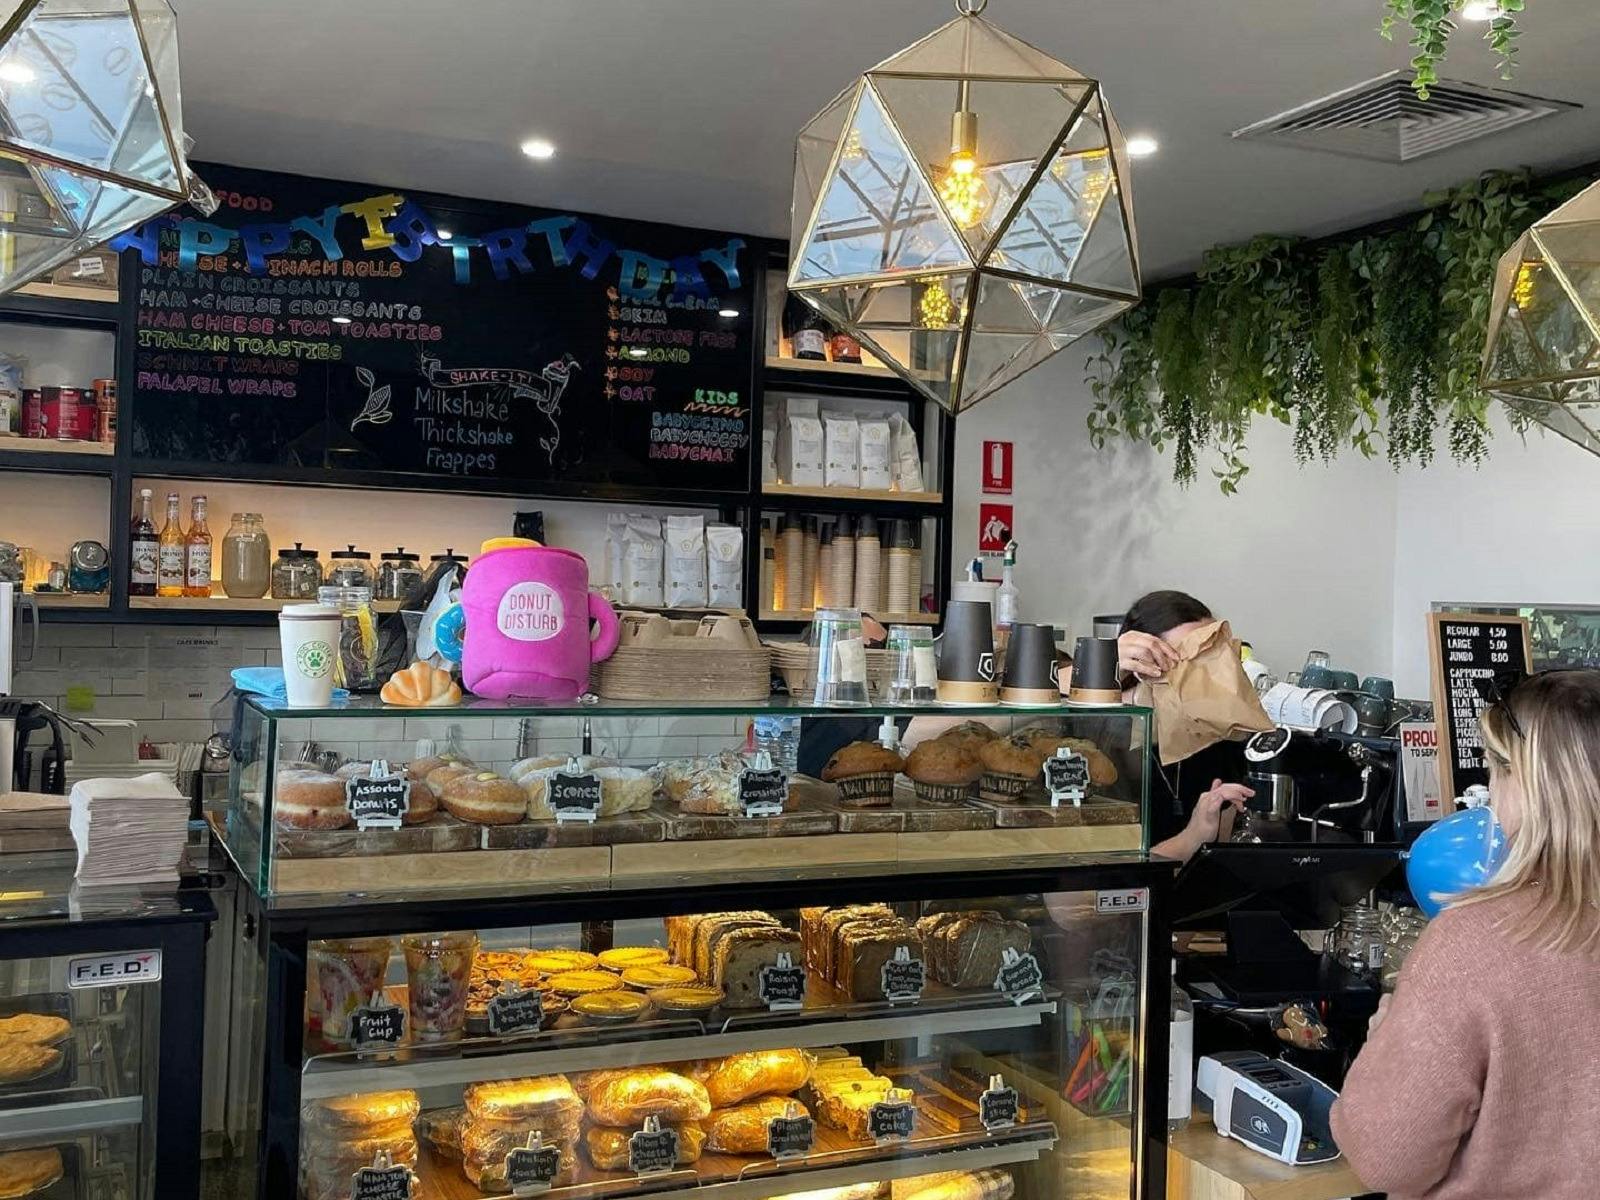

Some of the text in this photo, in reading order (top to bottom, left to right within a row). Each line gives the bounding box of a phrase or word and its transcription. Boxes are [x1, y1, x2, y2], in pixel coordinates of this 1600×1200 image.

[342, 261, 403, 278] ROLLS
[141, 268, 360, 298] PLAIN CROISSANTS
[139, 289, 188, 308] HAM
[201, 293, 282, 315] CHEESE
[288, 300, 423, 321] CROISSANTS
[620, 307, 669, 325] SKIM
[137, 310, 187, 329] HAM
[191, 313, 275, 335] CHEESE
[288, 319, 331, 337] TOM
[339, 322, 442, 341] TOASTIES
[138, 329, 342, 361] ITALIAN TOASTIES
[226, 378, 298, 398] WRAPS
[619, 385, 656, 402] OAT
[695, 388, 739, 405] KIDS
[414, 386, 509, 421] Milkshake
[414, 417, 514, 446] Thickshake
[426, 447, 497, 475] Frappes
[511, 593, 552, 612] DONUT
[505, 612, 558, 631] DISTURB
[1446, 625, 1480, 636] REGULAR
[1447, 638, 1473, 649] LARGE
[1449, 651, 1474, 662] JUMBO
[1450, 678, 1474, 688] LATTE
[1451, 688, 1480, 698] MOCHA
[1403, 729, 1438, 748] PROU
[1421, 748, 1438, 758] SERV
[1458, 748, 1473, 758] TEA
[554, 784, 599, 799] Scones
[1099, 895, 1142, 907] F.E.D.
[76, 960, 149, 979] F.E.D.
[359, 1013, 392, 1028] Fruit
